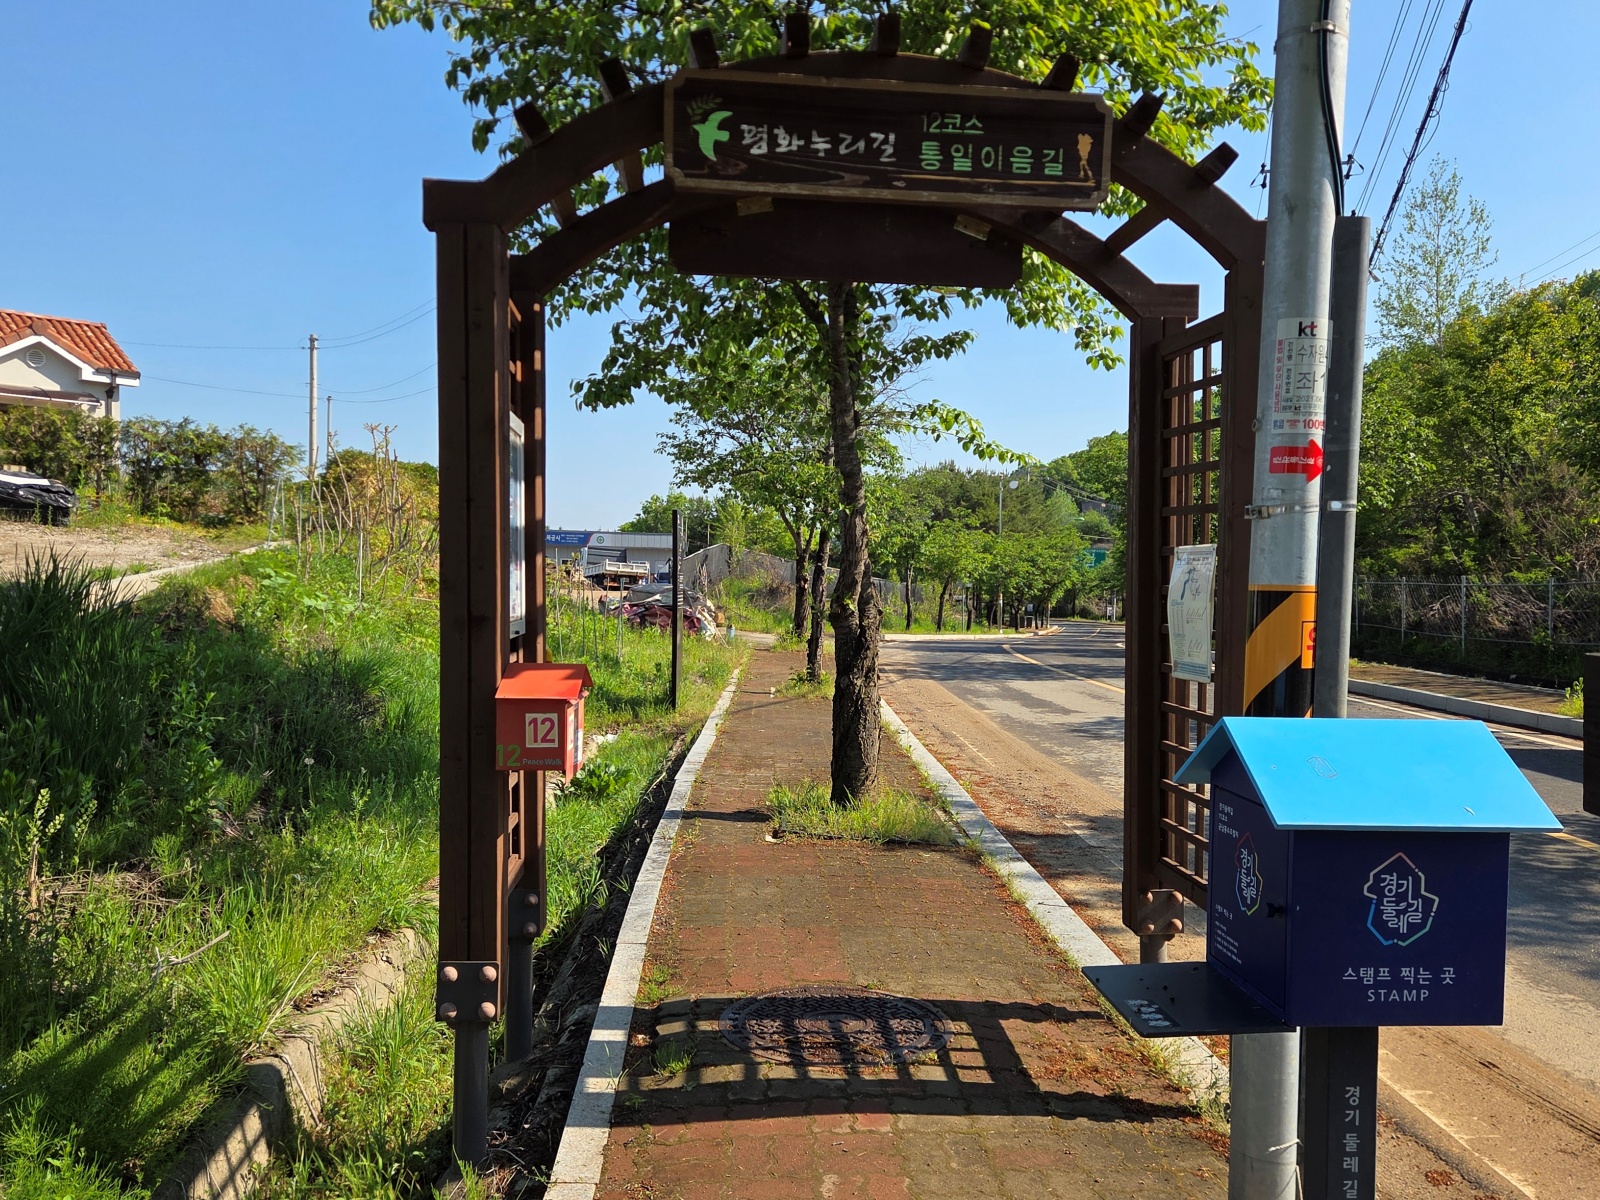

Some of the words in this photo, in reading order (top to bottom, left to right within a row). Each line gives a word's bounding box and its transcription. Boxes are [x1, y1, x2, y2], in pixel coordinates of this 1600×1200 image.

[921, 112, 984, 135] 12코스
[740, 124, 897, 162] 평화누리길
[919, 141, 1064, 176] 통일이음길
[1298, 321, 1318, 337] kt
[528, 717, 555, 744] 12
[496, 744, 521, 767] 12
[1342, 966, 1392, 985] 스탬프
[1400, 966, 1433, 985] 찍는
[1440, 966, 1456, 985] 곳
[1367, 989, 1429, 1002] STAMP
